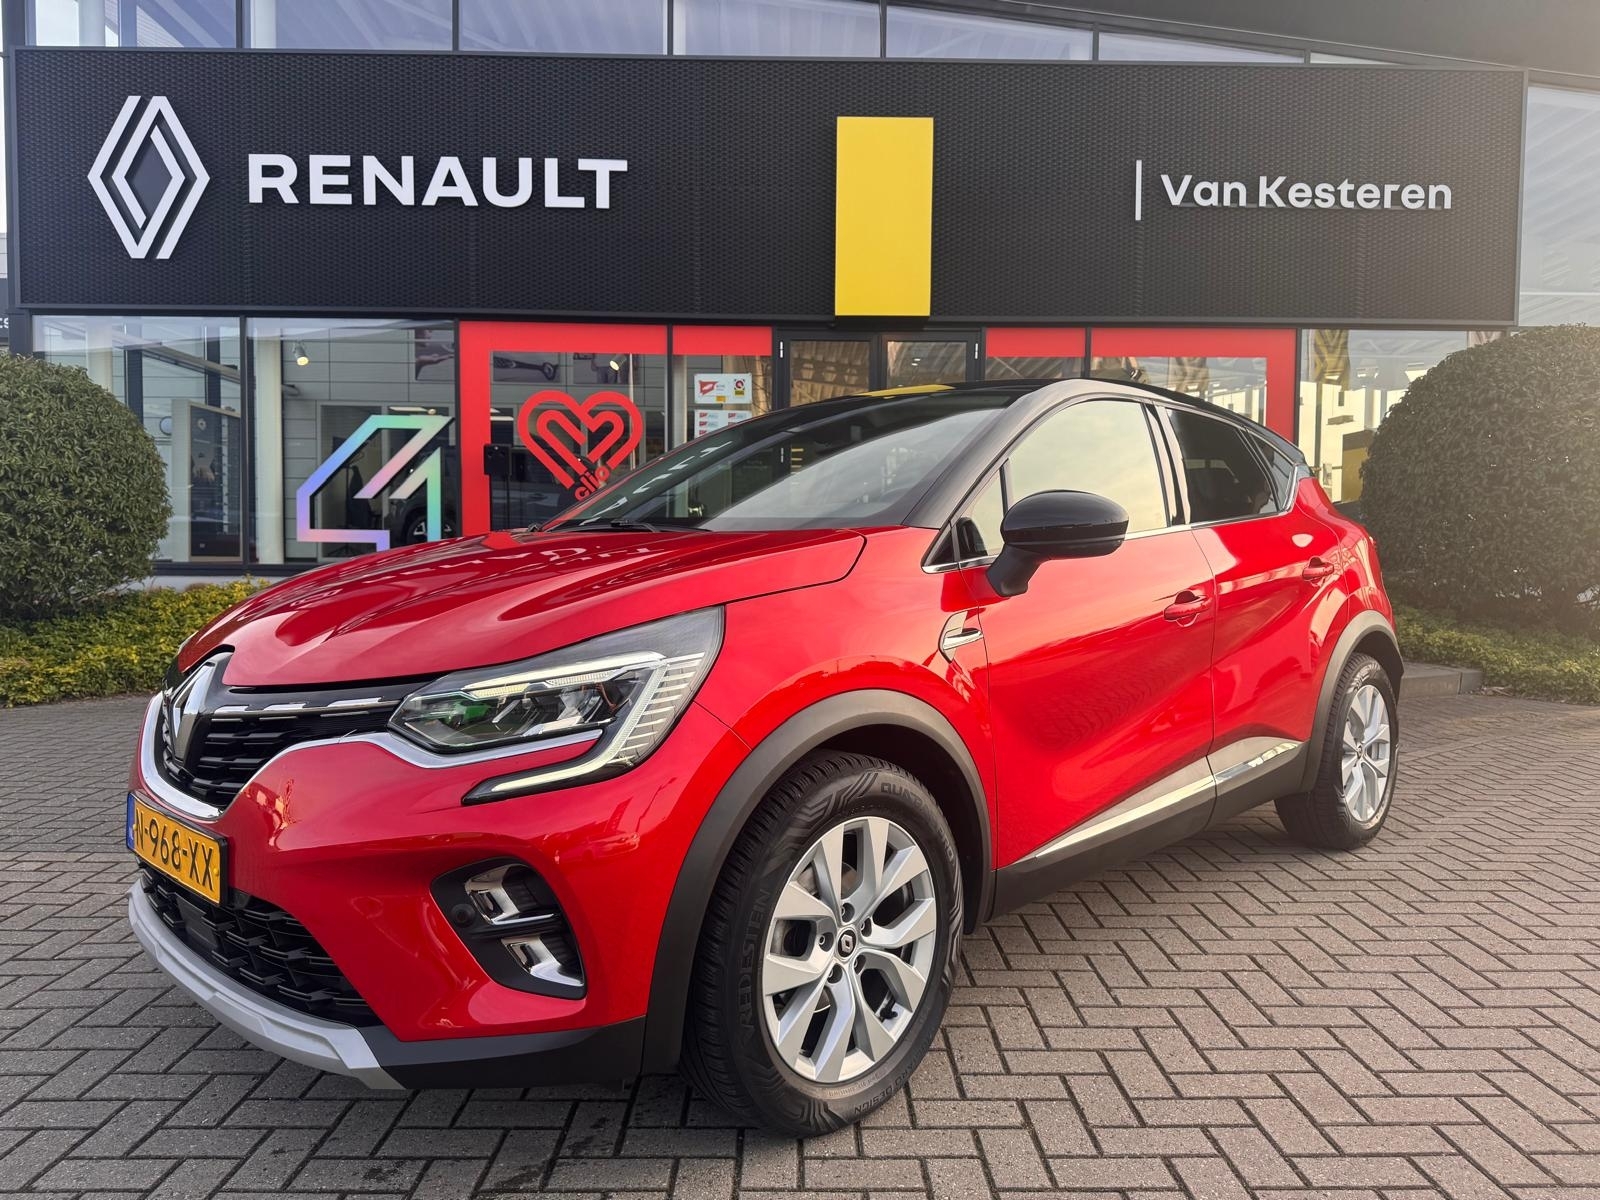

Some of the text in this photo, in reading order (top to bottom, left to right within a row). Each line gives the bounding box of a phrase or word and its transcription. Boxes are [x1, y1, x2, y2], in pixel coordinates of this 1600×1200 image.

[248, 153, 628, 210] RENAULT
[1160, 174, 1453, 211] Van Kesteren
[574, 465, 611, 502] clio
[135, 806, 214, 892] N-968-XX
